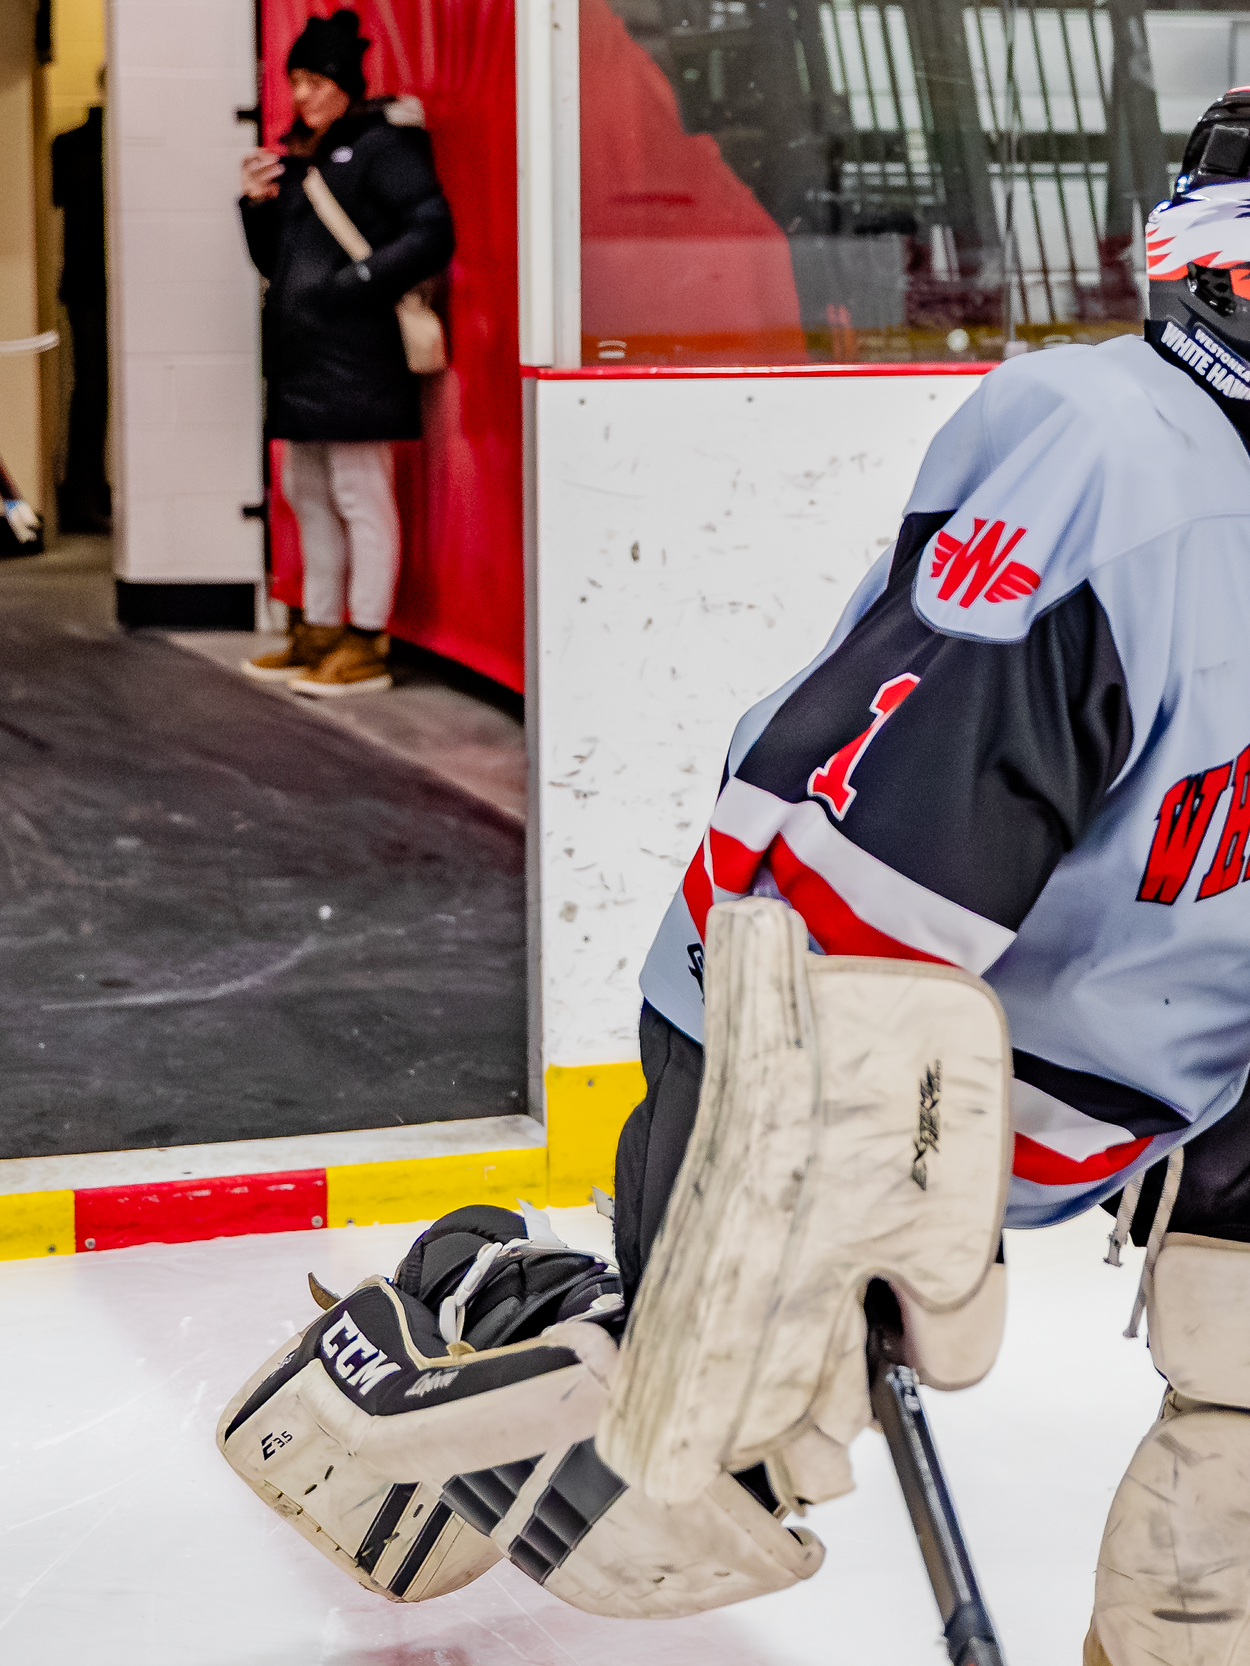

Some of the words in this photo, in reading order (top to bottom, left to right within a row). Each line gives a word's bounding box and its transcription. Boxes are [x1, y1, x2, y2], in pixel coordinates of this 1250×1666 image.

[1161, 321, 1208, 378] WHITE
[807, 672, 921, 821] 1
[320, 1310, 402, 1396] CCM
